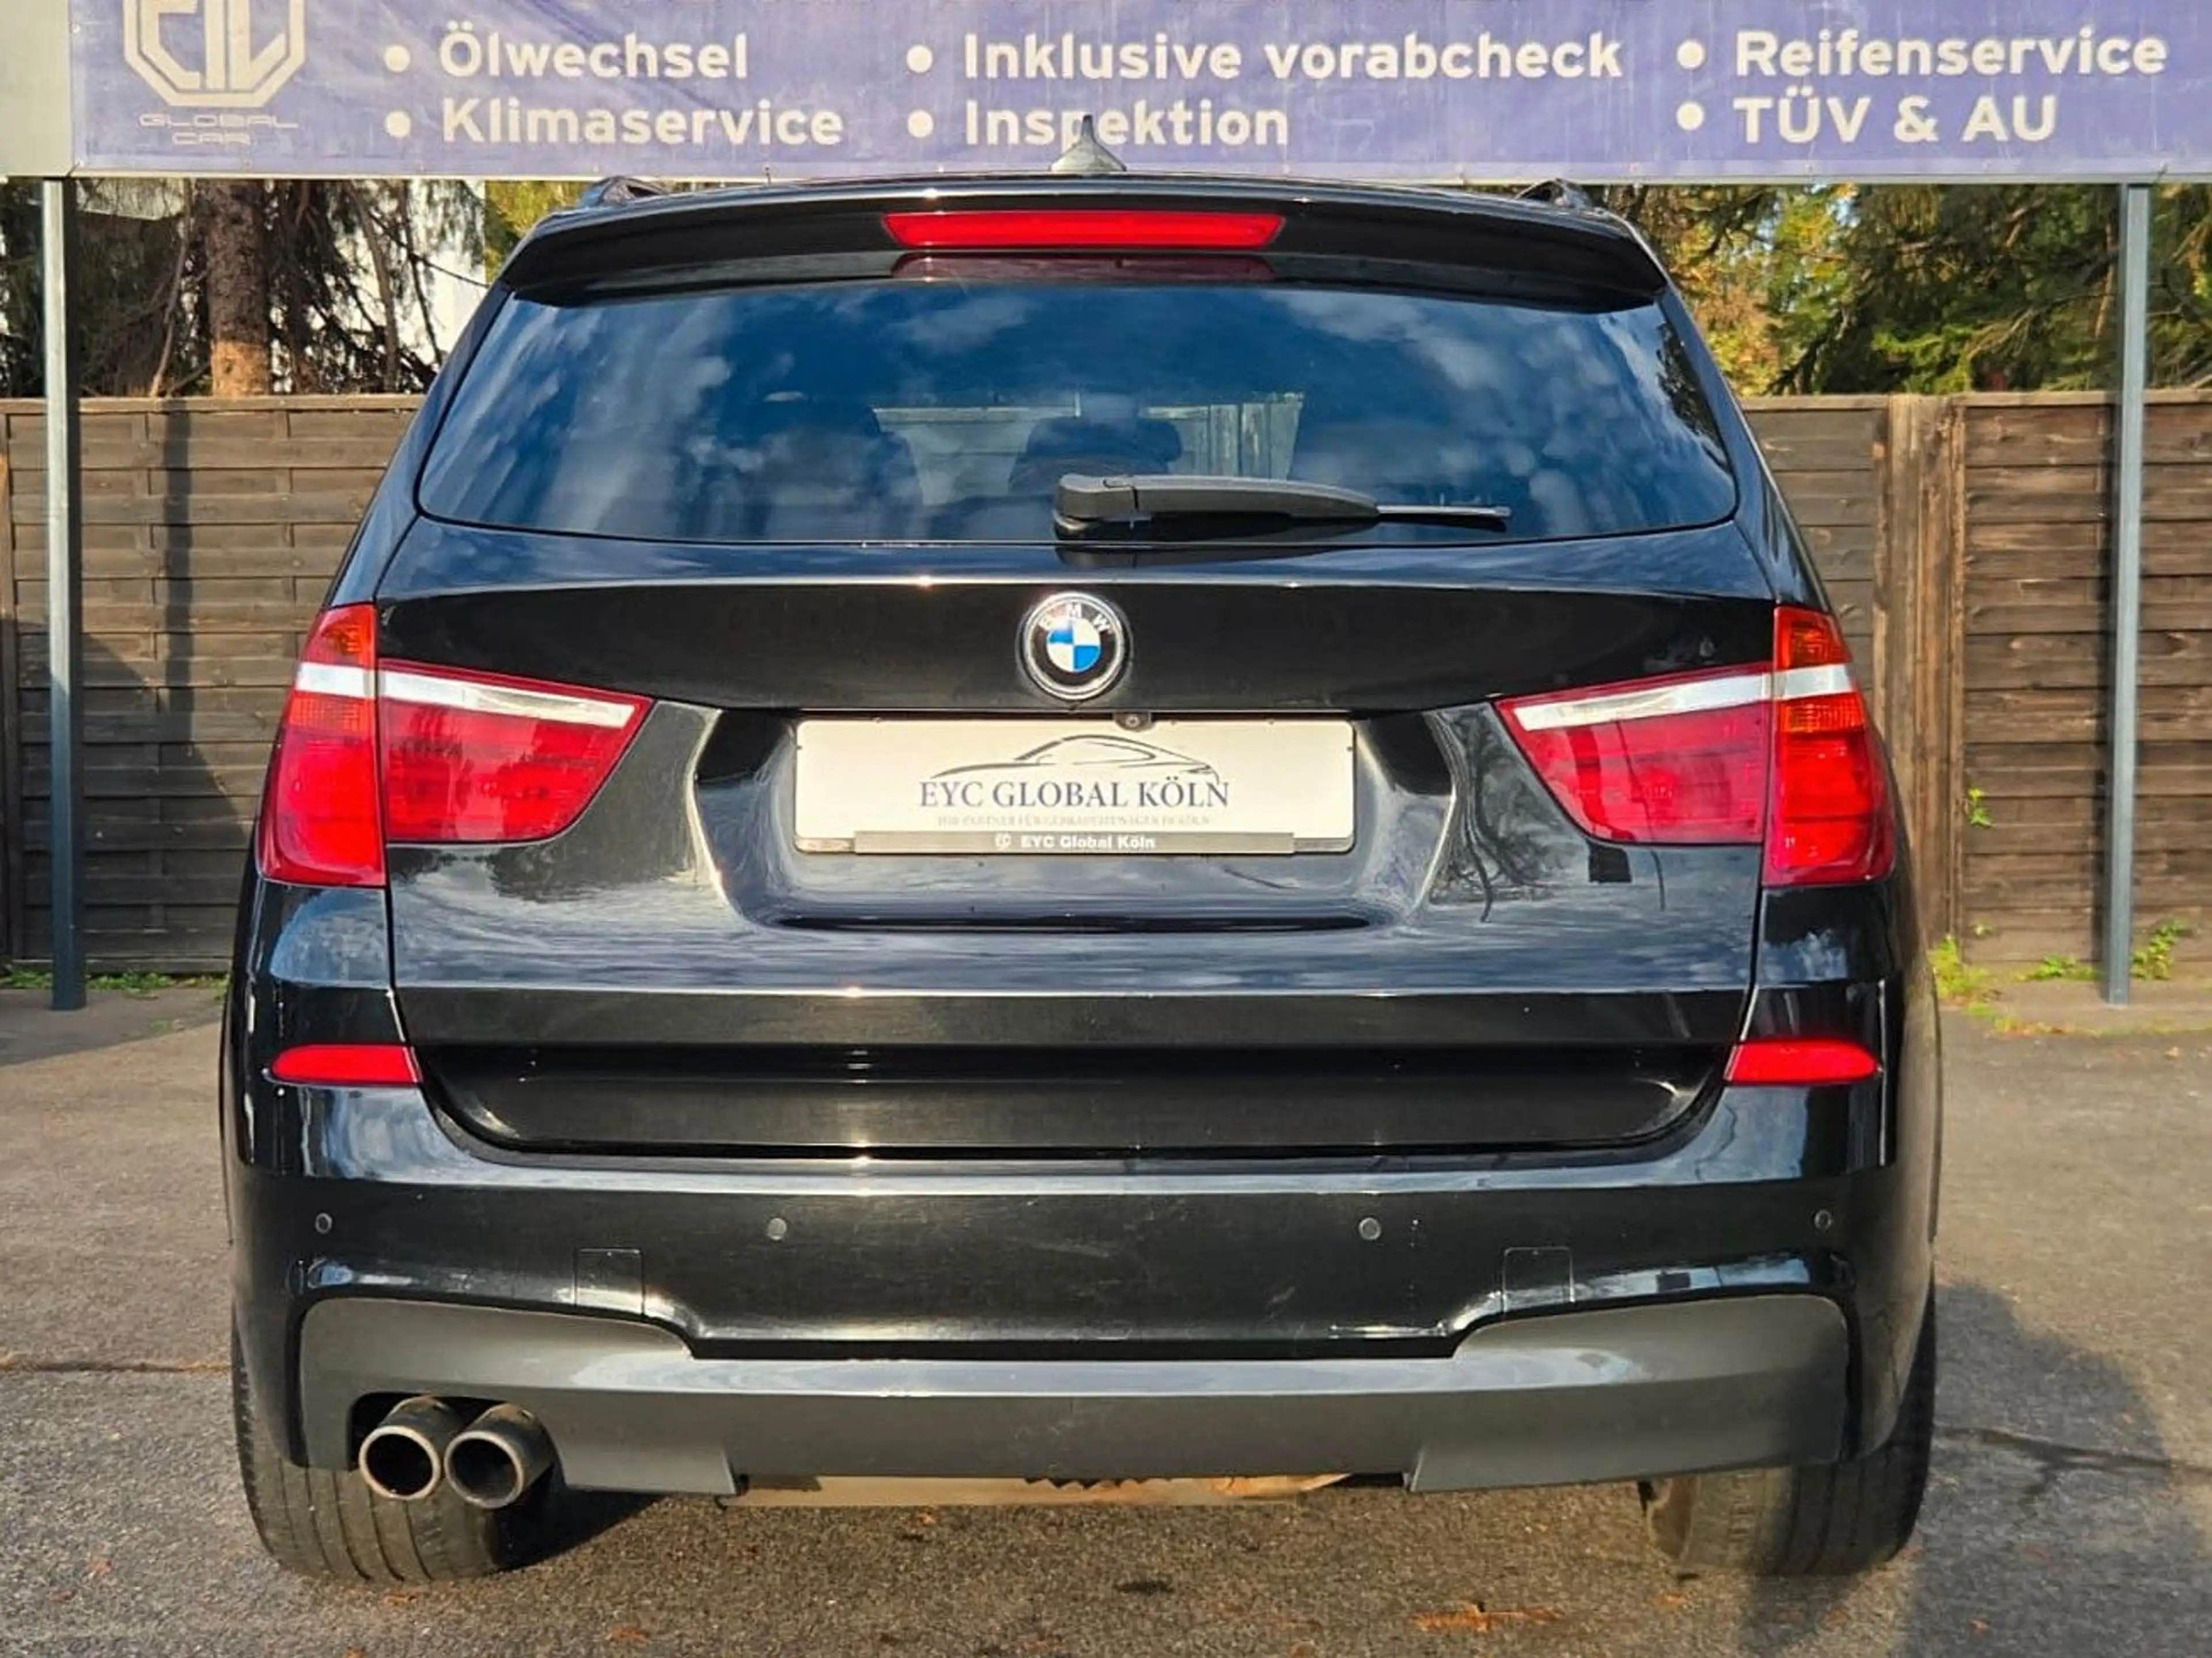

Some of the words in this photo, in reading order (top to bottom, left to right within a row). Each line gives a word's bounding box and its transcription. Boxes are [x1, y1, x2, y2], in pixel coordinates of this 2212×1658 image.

[440, 21, 748, 78] Ölwechsel
[965, 32, 1242, 80] Inklusive
[1264, 31, 1623, 79] vorabcheck
[1736, 29, 2168, 77] Reifenservice
[139, 113, 300, 129] GLOBAL
[442, 96, 844, 145] Klimaservice
[965, 99, 1289, 150] Inspektion
[1733, 85, 1872, 144] TÜV
[1893, 95, 1940, 143] &
[1962, 94, 2056, 143] AU
[921, 781, 984, 807] EYC
[992, 781, 1128, 807] GLOBAL
[1138, 775, 1229, 808] KÖLN
[1020, 835, 1055, 849] EYC
[1059, 834, 1112, 850] Global
[1117, 835, 1156, 849] Köln
